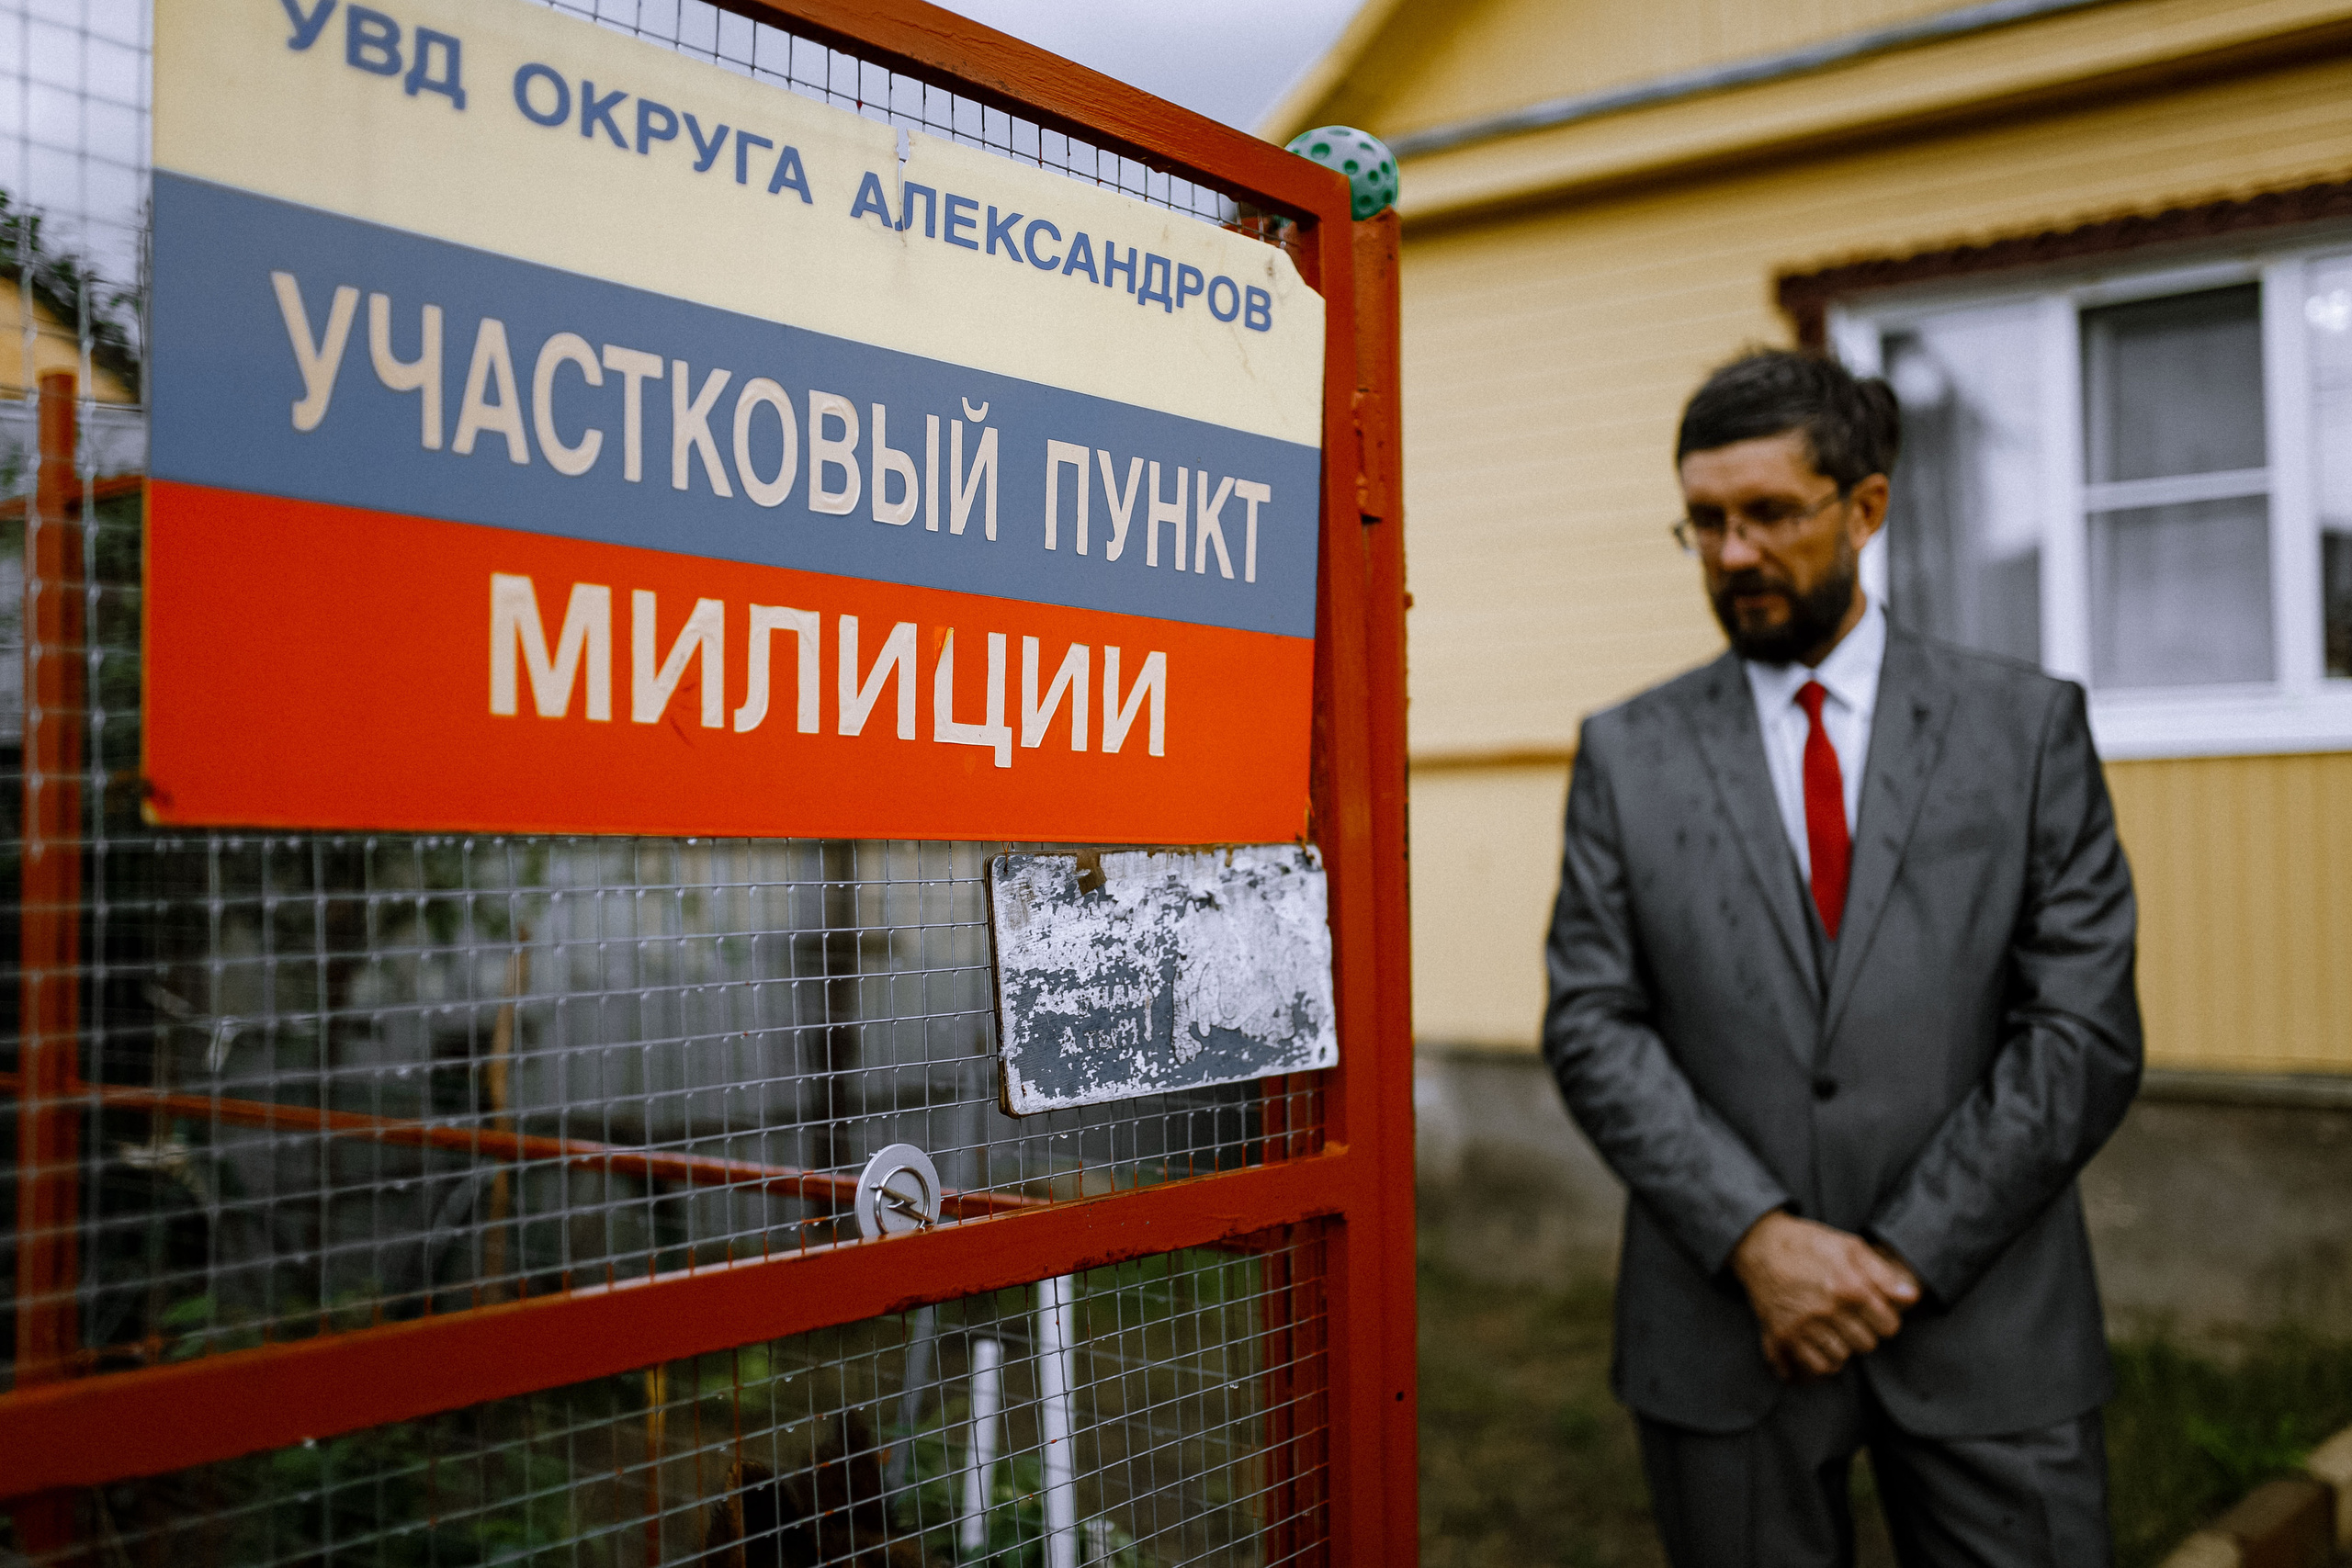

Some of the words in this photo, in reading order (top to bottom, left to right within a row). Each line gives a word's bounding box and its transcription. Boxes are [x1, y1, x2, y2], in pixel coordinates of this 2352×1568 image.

[281, 0, 467, 111] УВД
[512, 62, 814, 205] ОКРУГА
[849, 170, 1273, 333] АЛЕКСАНДРОВ
[271, 271, 1000, 543] УЧАСТКОВЫЙ
[1044, 437, 1272, 584] ПУНКТ
[490, 571, 1168, 769] МИЛИЦИИ
